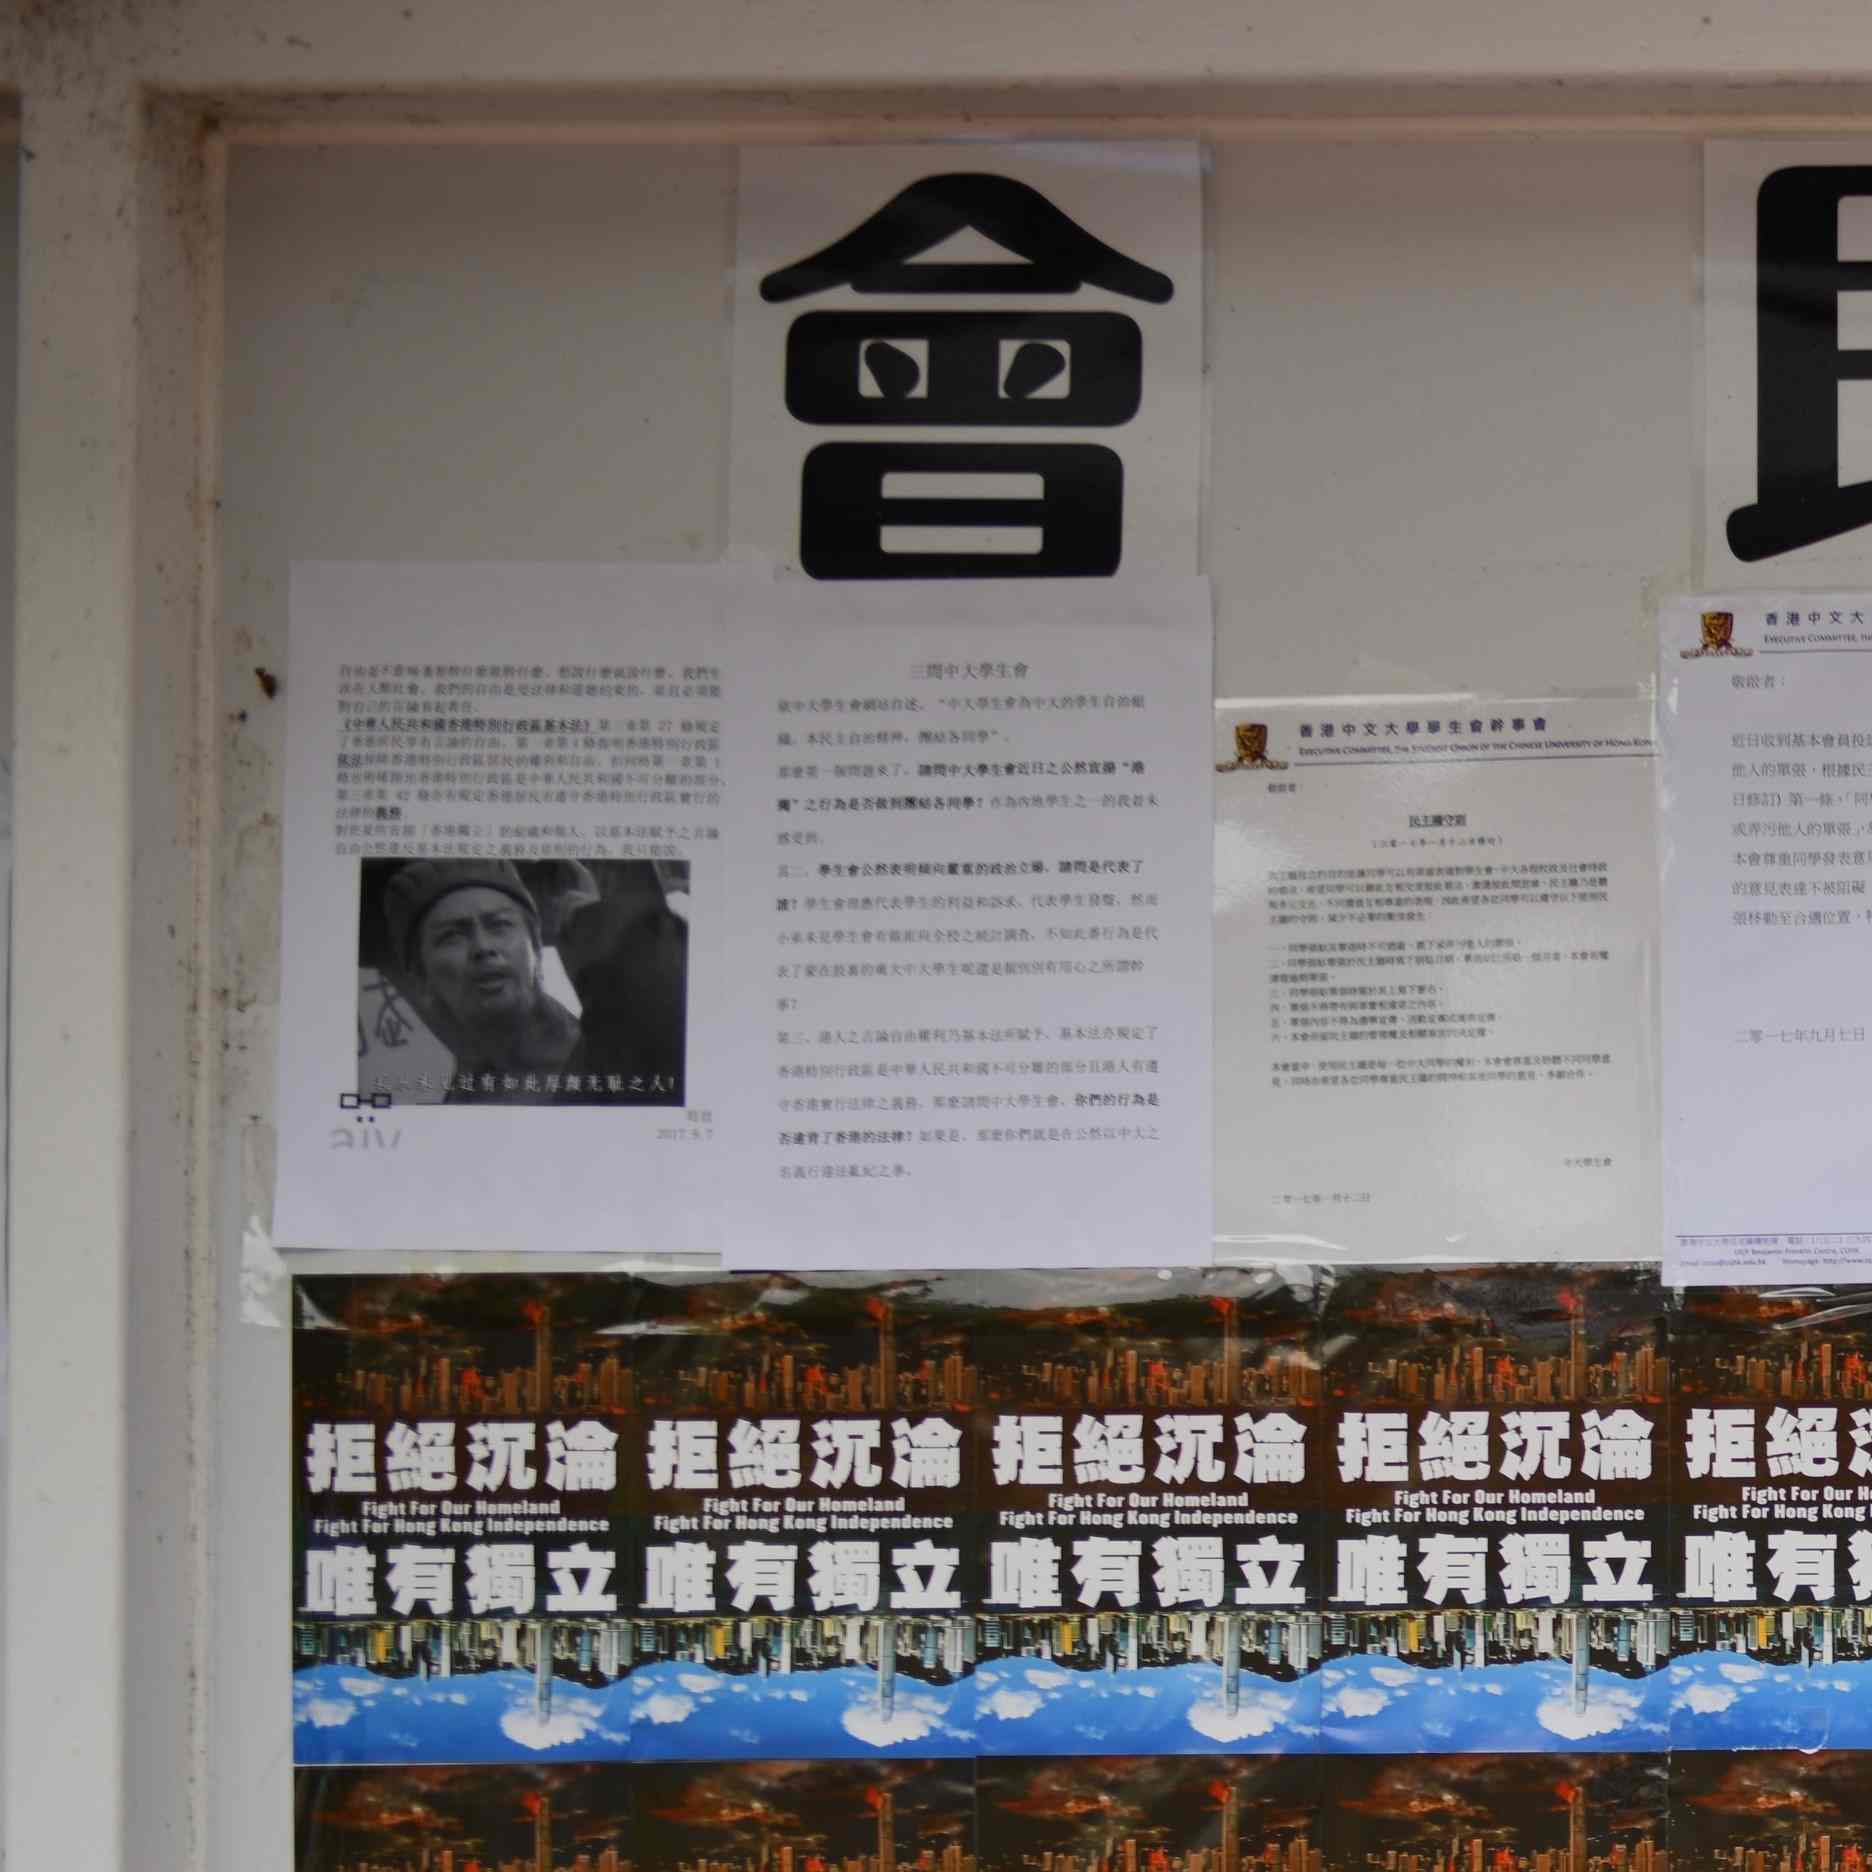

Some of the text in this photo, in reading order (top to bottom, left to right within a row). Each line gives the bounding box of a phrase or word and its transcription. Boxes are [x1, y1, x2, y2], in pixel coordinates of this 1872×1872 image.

[760, 172, 1173, 580] 會
[911, 661, 1031, 681] 三問中大學生會
[647, 1418, 962, 1489] 拒絕沉淪
[1337, 1410, 1654, 1482] 拒絕沉淪
[653, 1516, 953, 1533] Fight For Hong Kong Independence
[703, 1497, 906, 1514] Fight For Our Homeland
[645, 1540, 961, 1612] 唯有獨立
[1335, 1532, 1653, 1605] 唯有獨立
